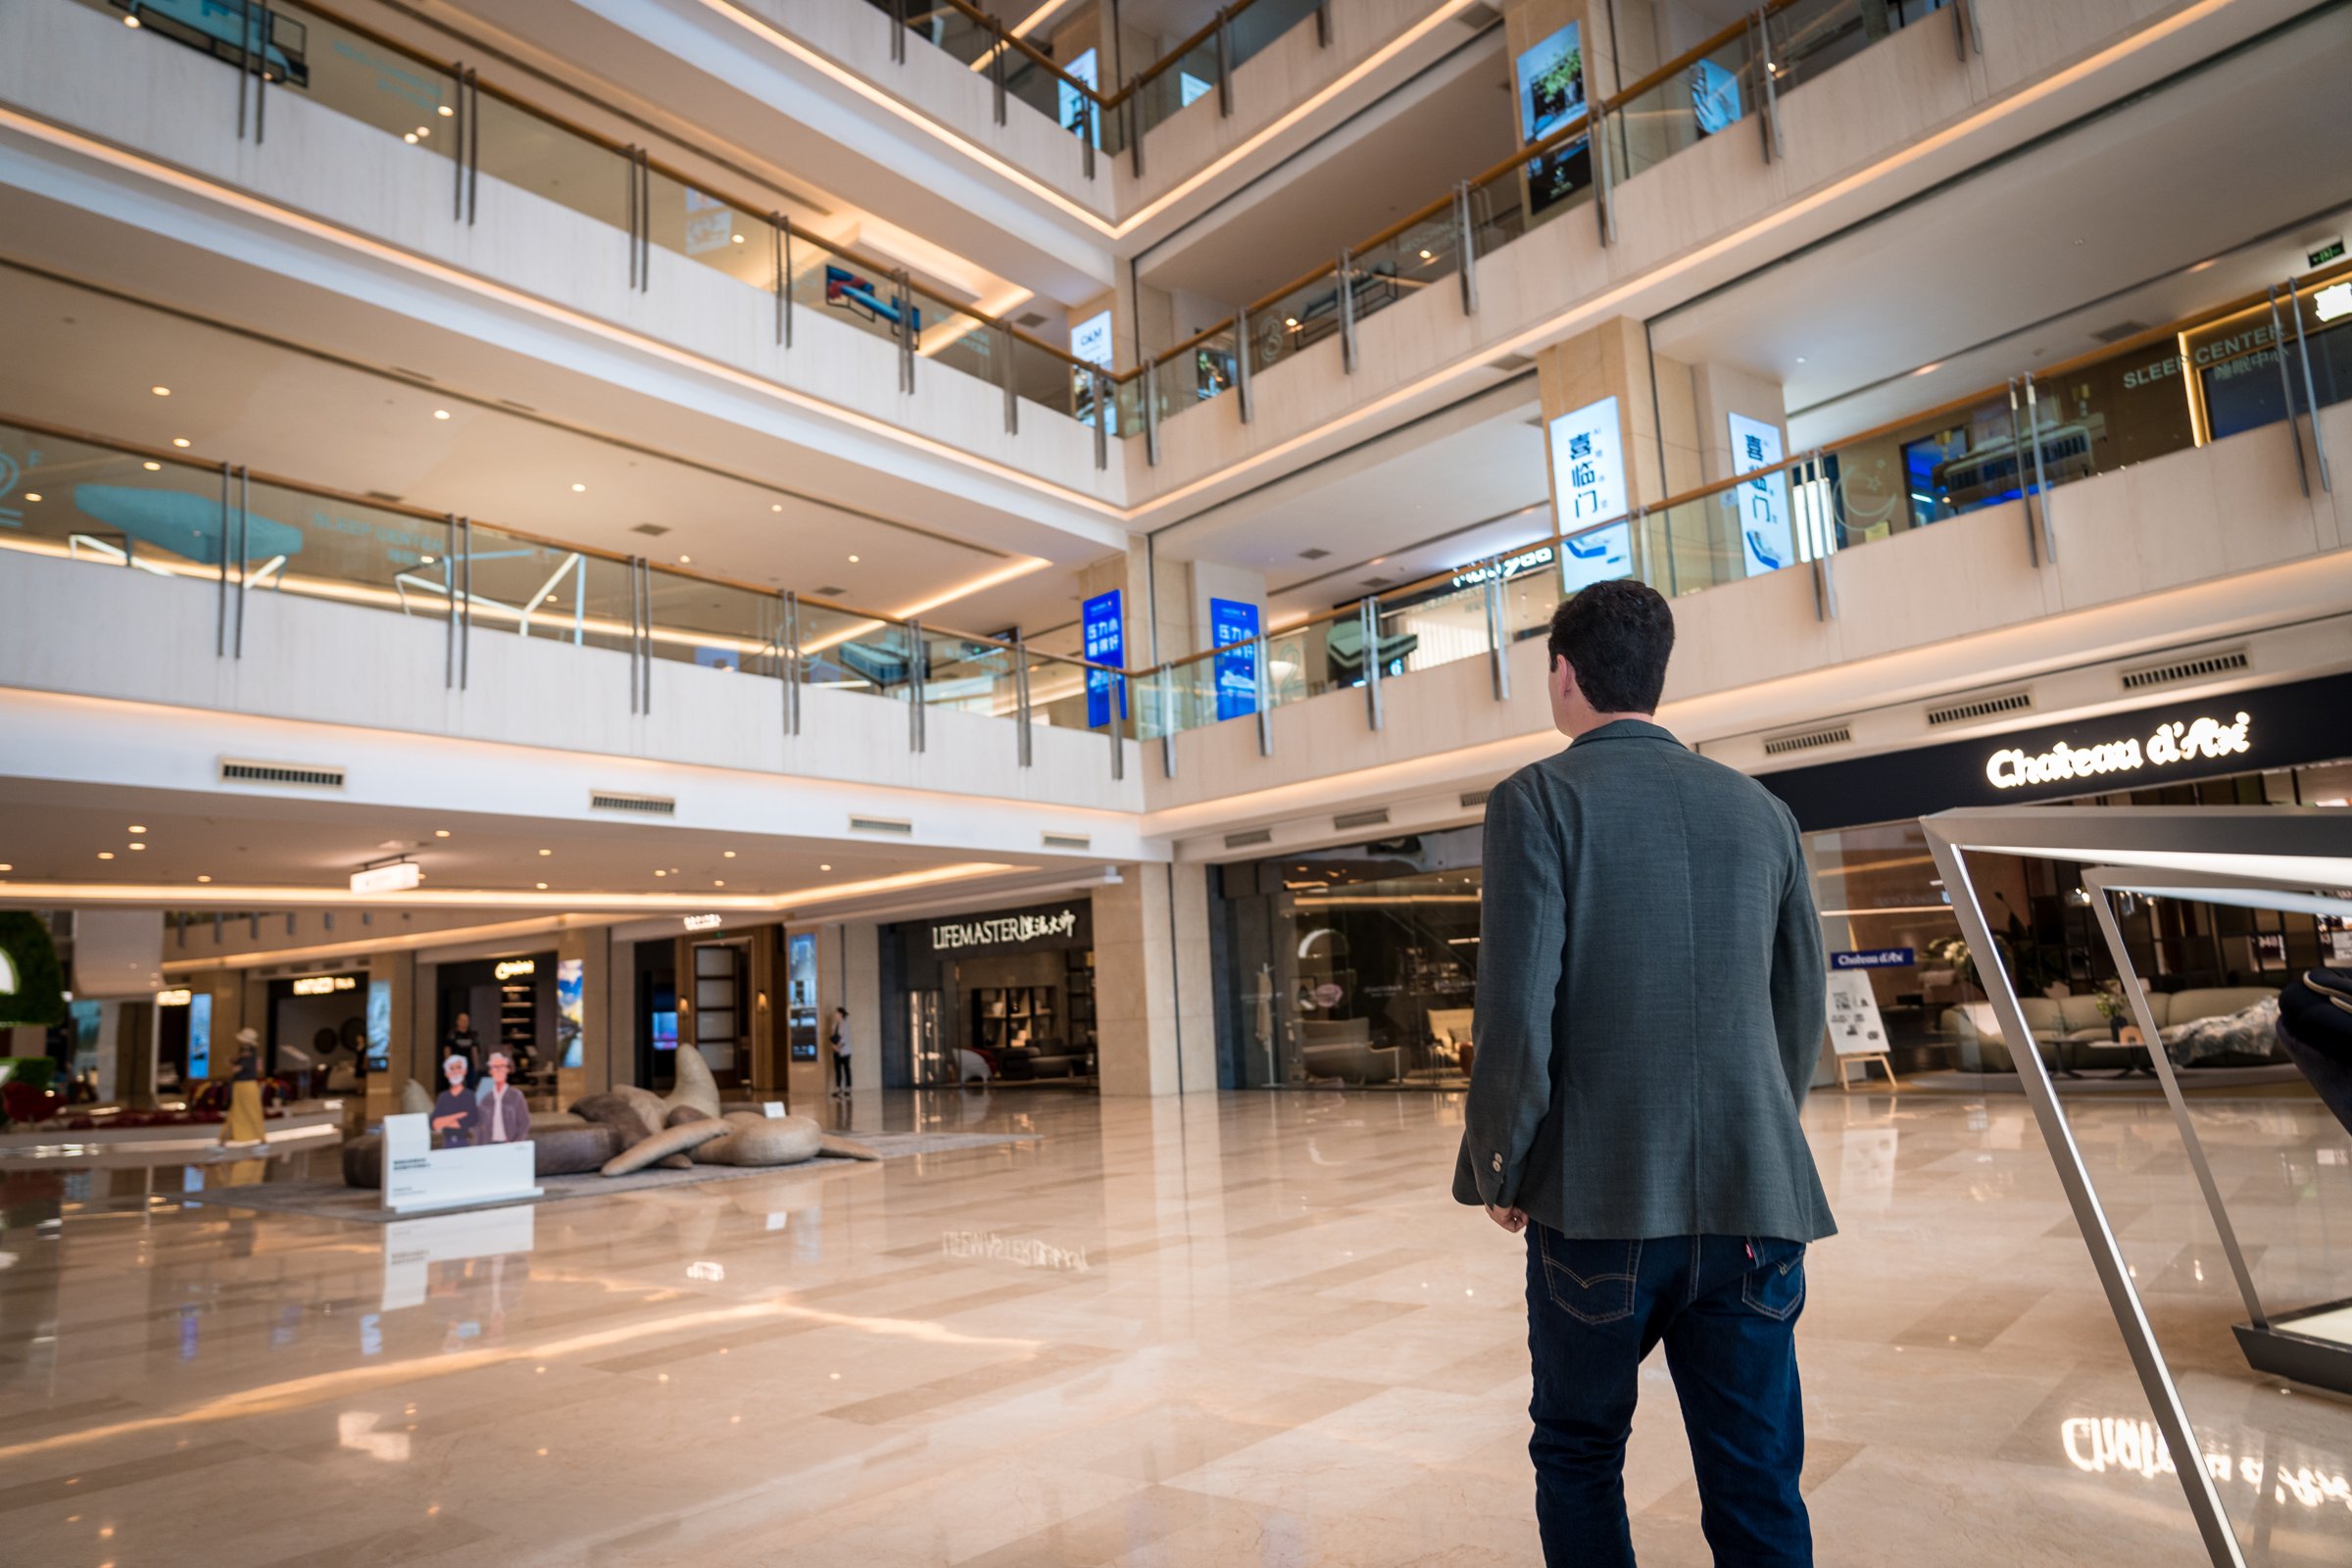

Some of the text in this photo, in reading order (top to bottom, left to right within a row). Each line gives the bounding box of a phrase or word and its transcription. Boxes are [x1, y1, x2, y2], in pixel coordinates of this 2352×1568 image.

[1568, 431, 1599, 518] 喜临门
[1986, 741, 2144, 789] Chateau
[932, 917, 1023, 950] LIFEMASTER
